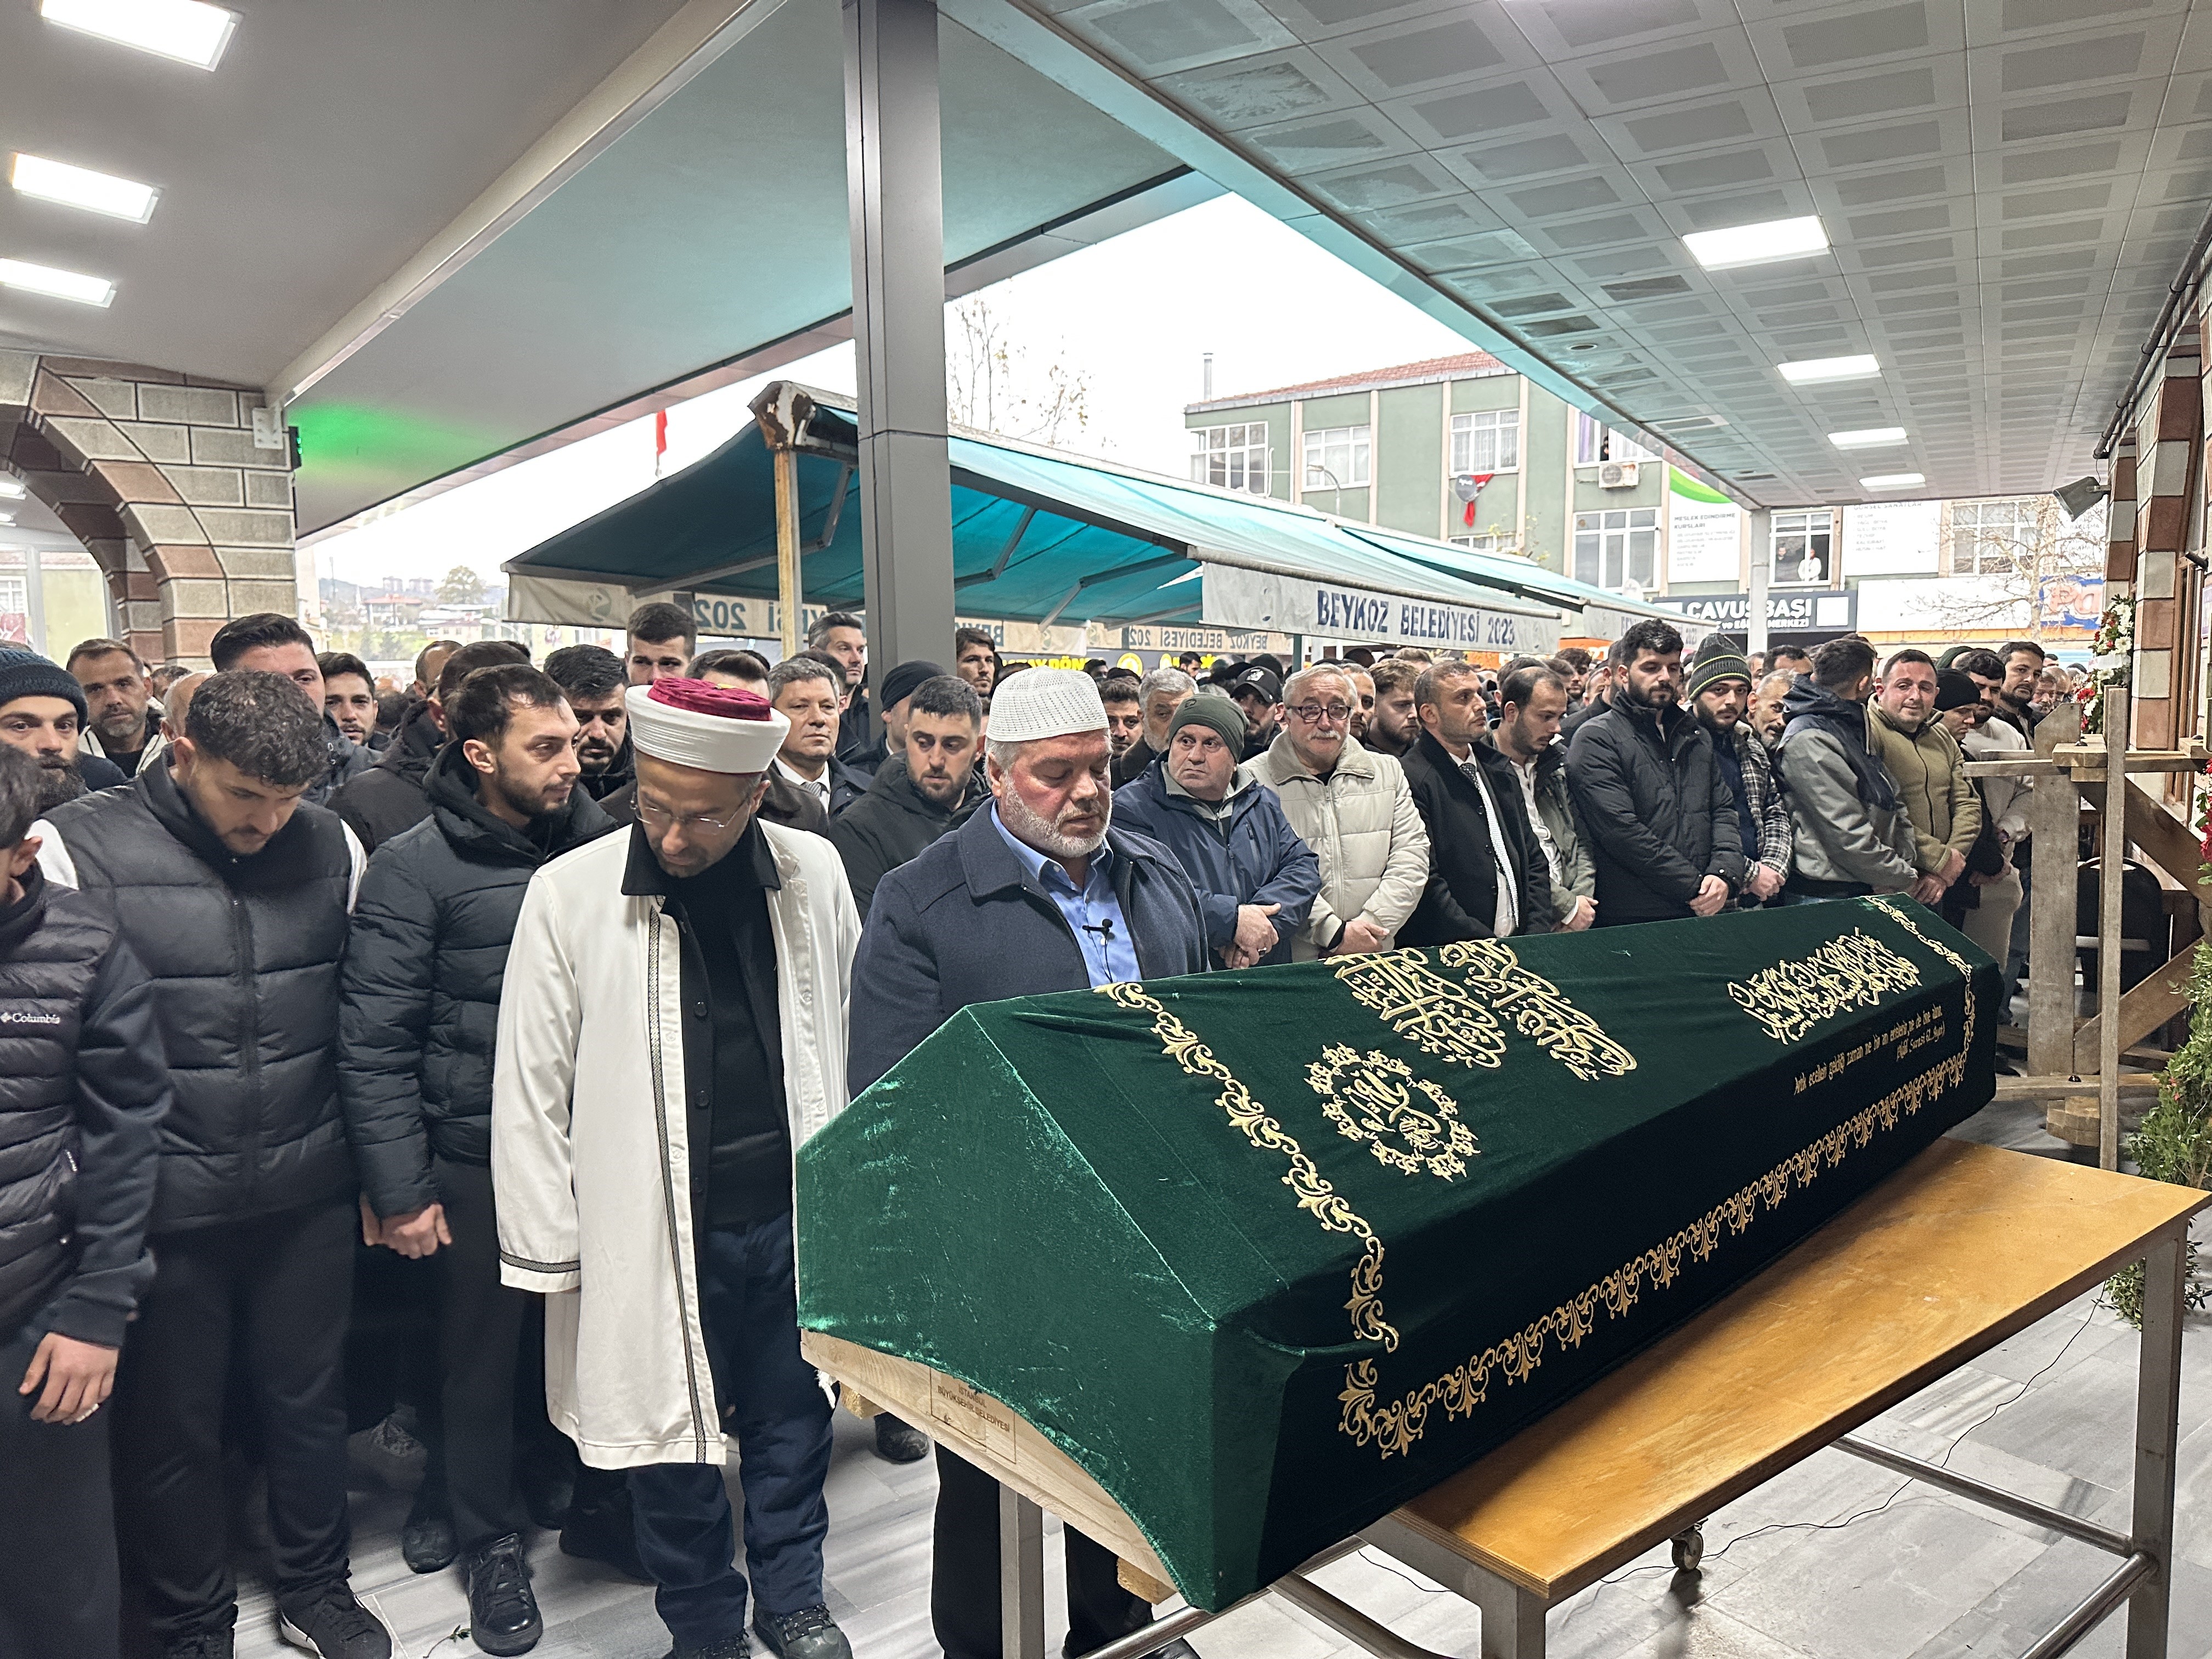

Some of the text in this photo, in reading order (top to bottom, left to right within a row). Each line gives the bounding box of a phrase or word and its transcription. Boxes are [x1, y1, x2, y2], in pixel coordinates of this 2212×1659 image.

[1317, 590, 1515, 646] BEYKOZ BELEDİYESİ 2023
[12, 1013, 60, 1024] Columbia
[1847, 1046, 1864, 1066] zaman
[958, 1384, 986, 1408] İSTANBUL
